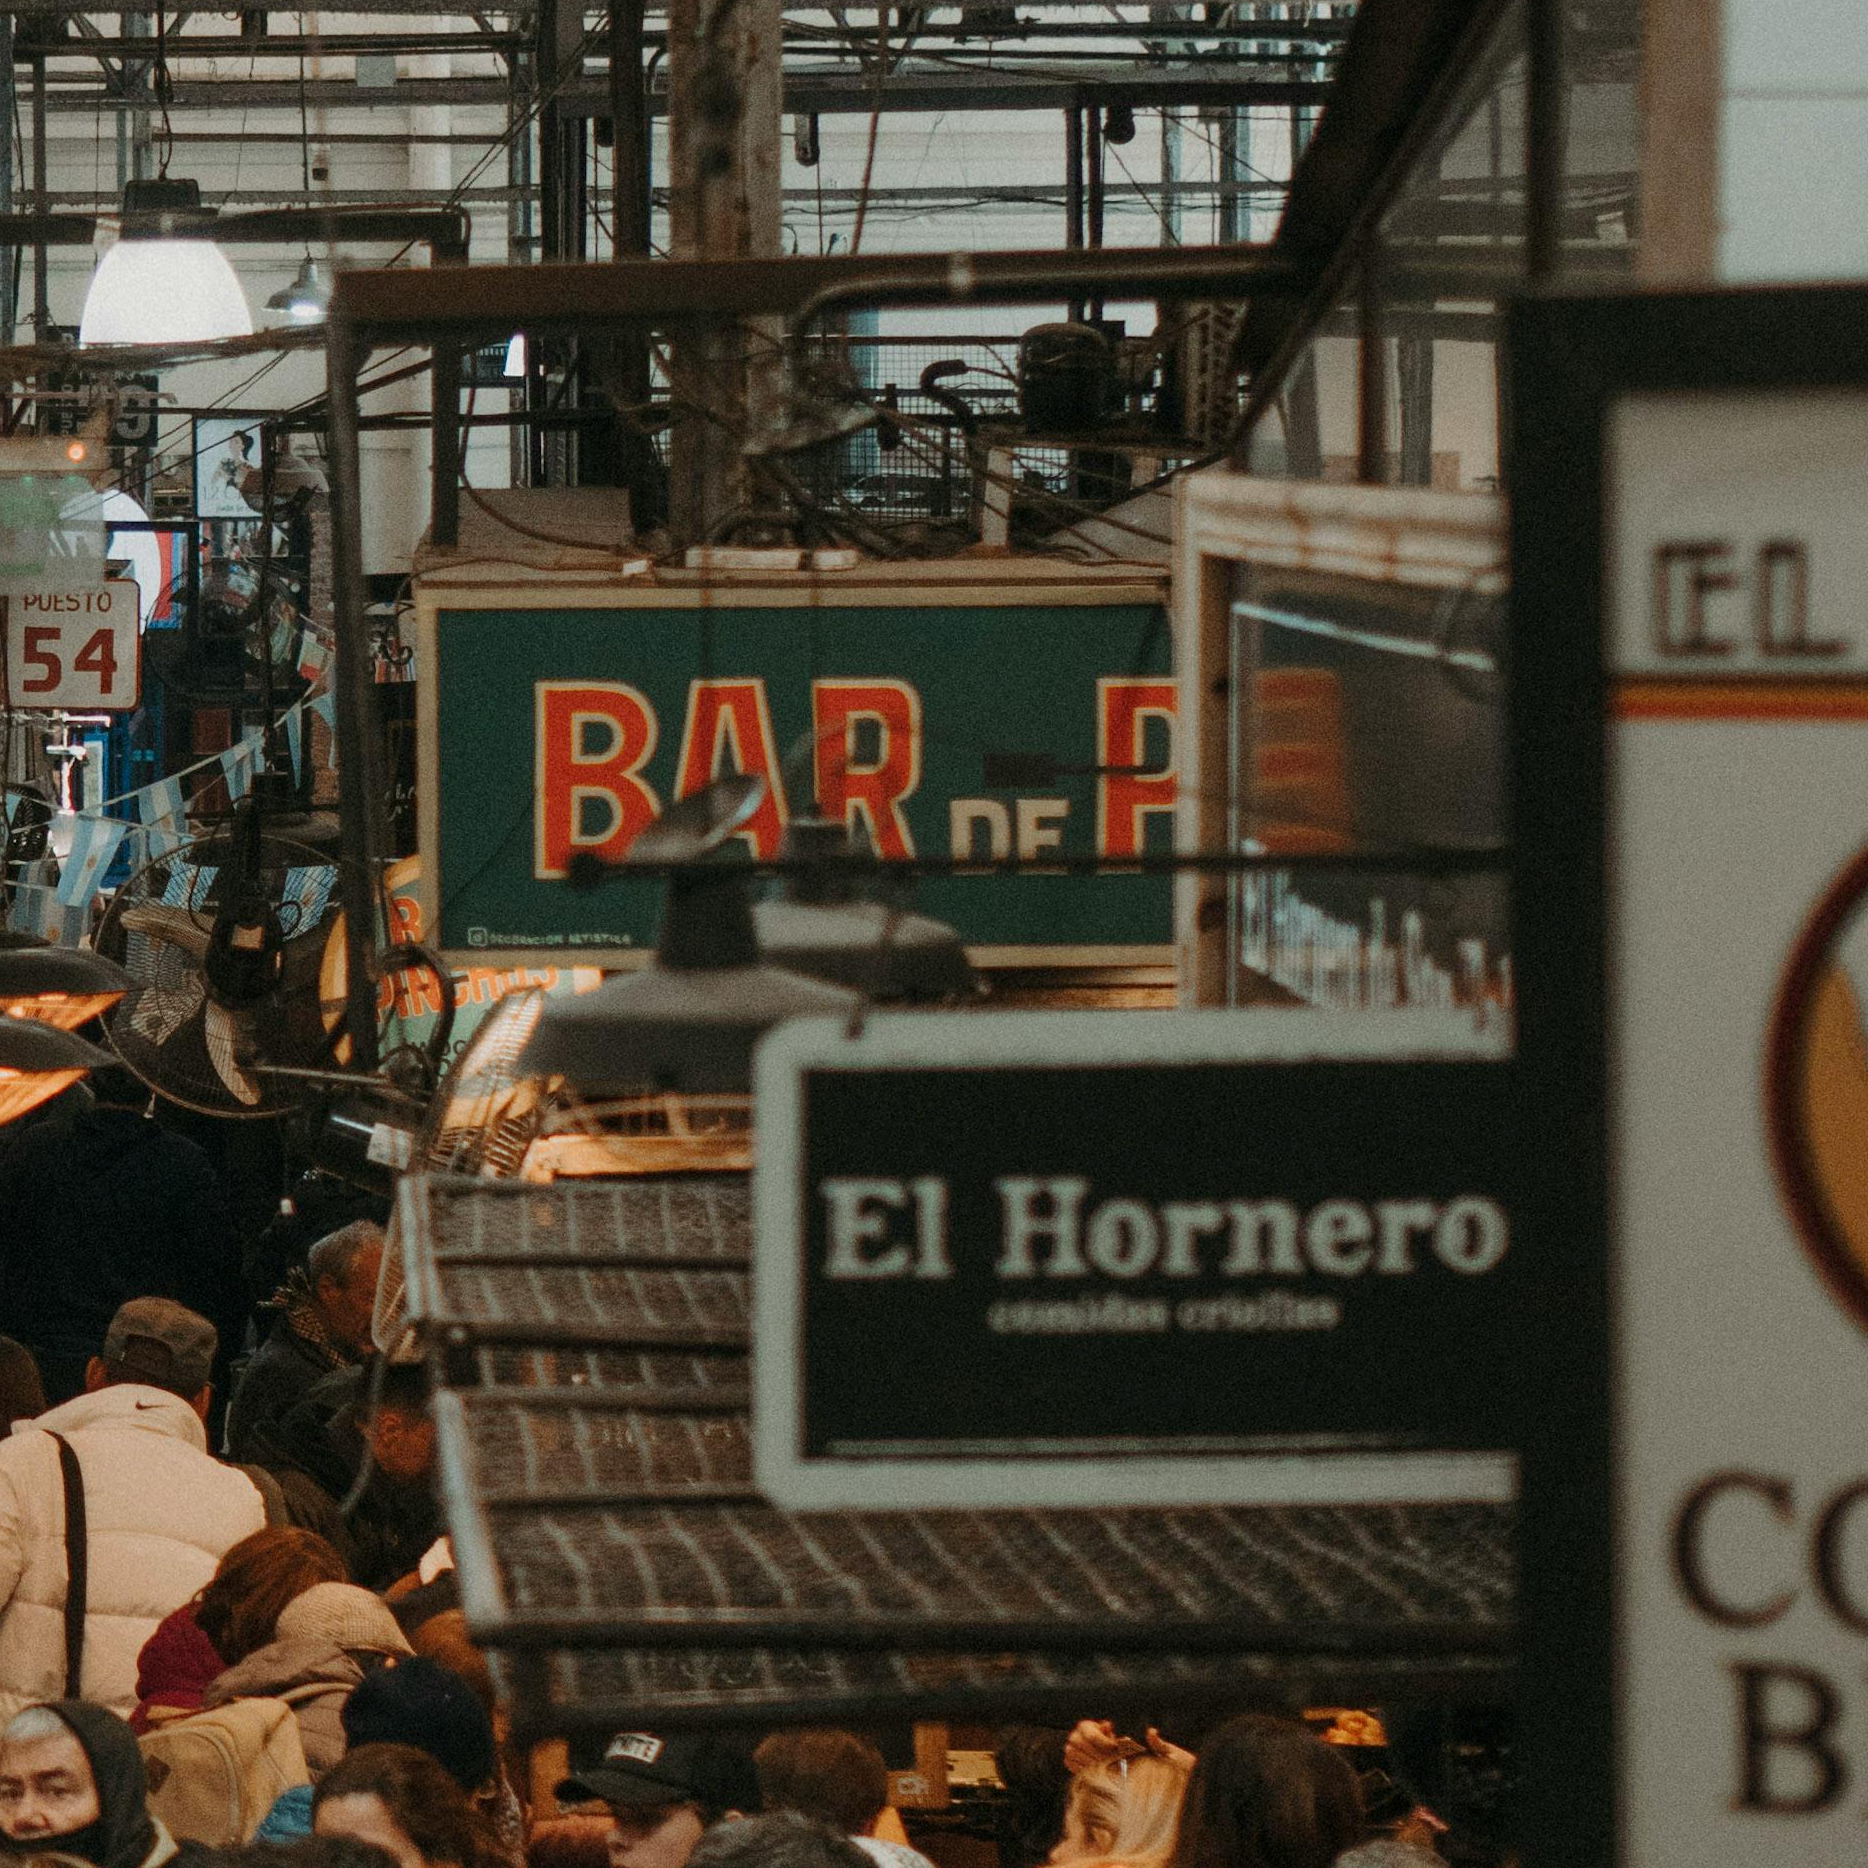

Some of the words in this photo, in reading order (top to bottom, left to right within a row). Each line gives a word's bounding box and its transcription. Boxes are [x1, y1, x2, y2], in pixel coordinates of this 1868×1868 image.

[22, 591, 112, 613] PUESTO
[22, 626, 118, 695] 54
[533, 677, 921, 881] BAR
[950, 797, 1072, 874] DE
[1096, 676, 1176, 874] P
[820, 1176, 954, 1281] El
[990, 1175, 1511, 1281] Hornero
[1725, 1657, 1868, 1820] B
